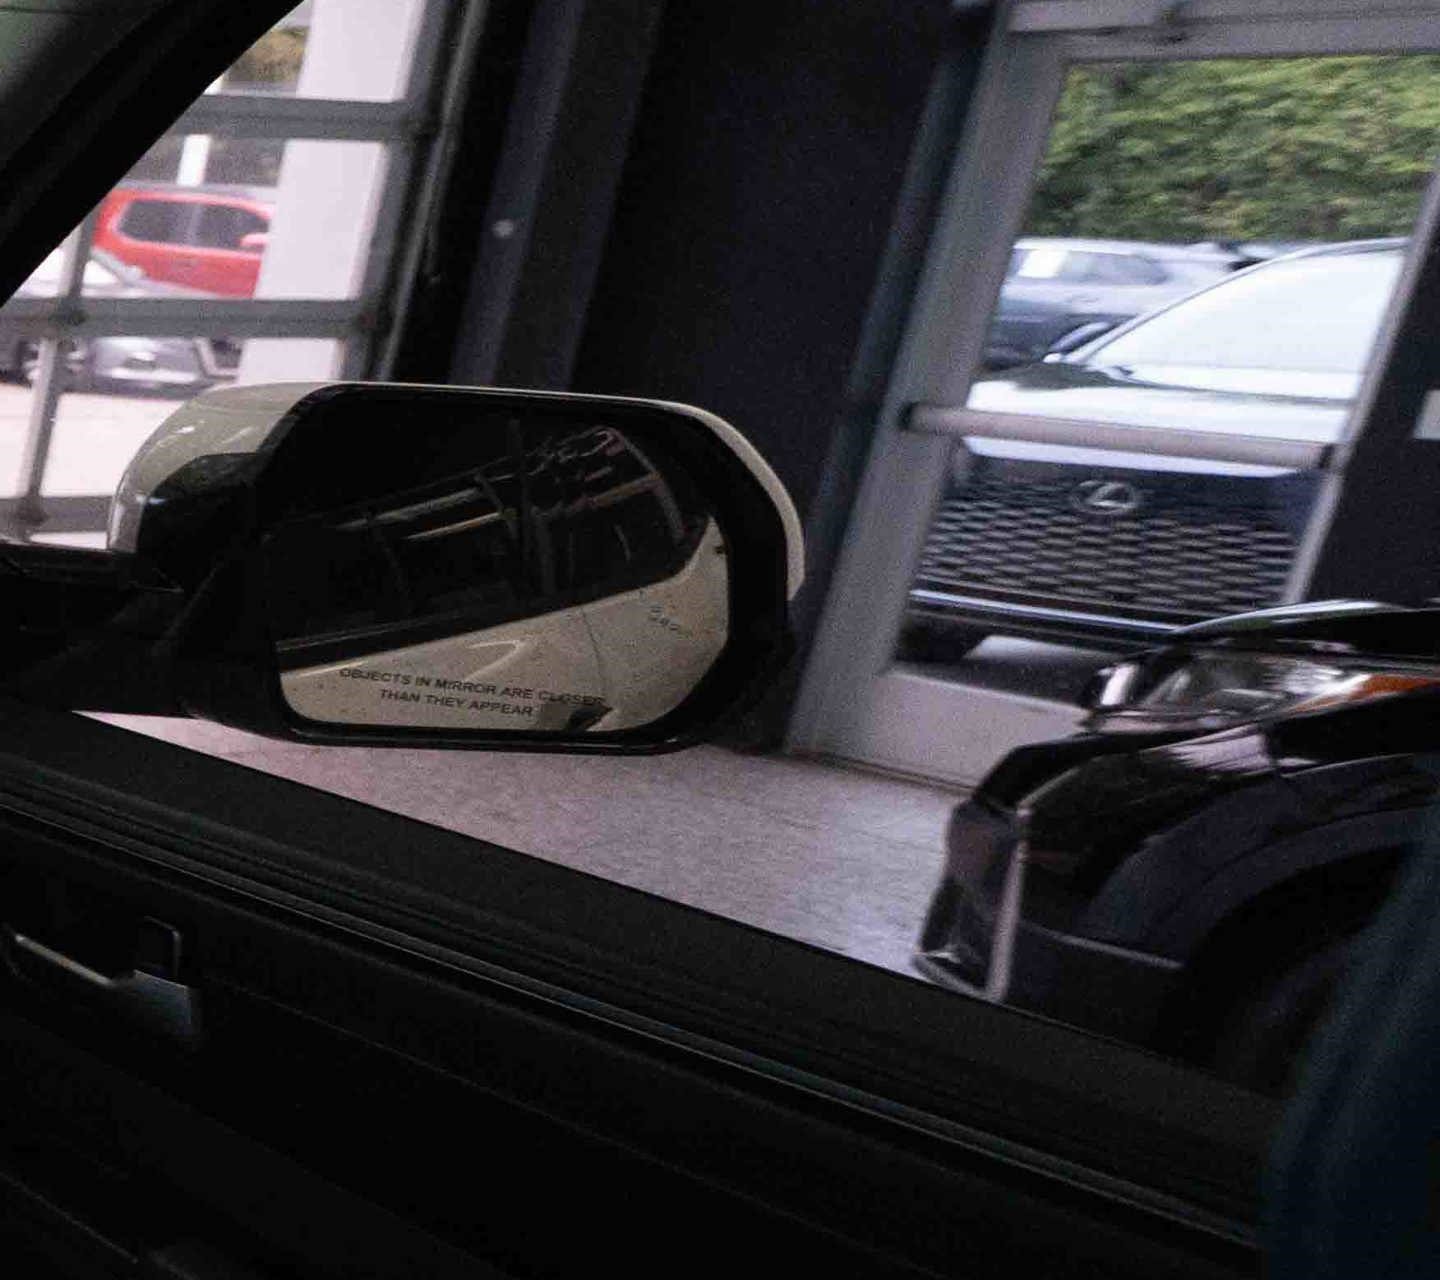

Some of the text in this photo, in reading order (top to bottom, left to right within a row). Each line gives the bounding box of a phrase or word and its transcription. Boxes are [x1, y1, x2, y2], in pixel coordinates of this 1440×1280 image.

[339, 669, 606, 706] OBJECTS IN MIRROR ARE CLOSER
[380, 689, 532, 716] THAN THEY APPEAR
